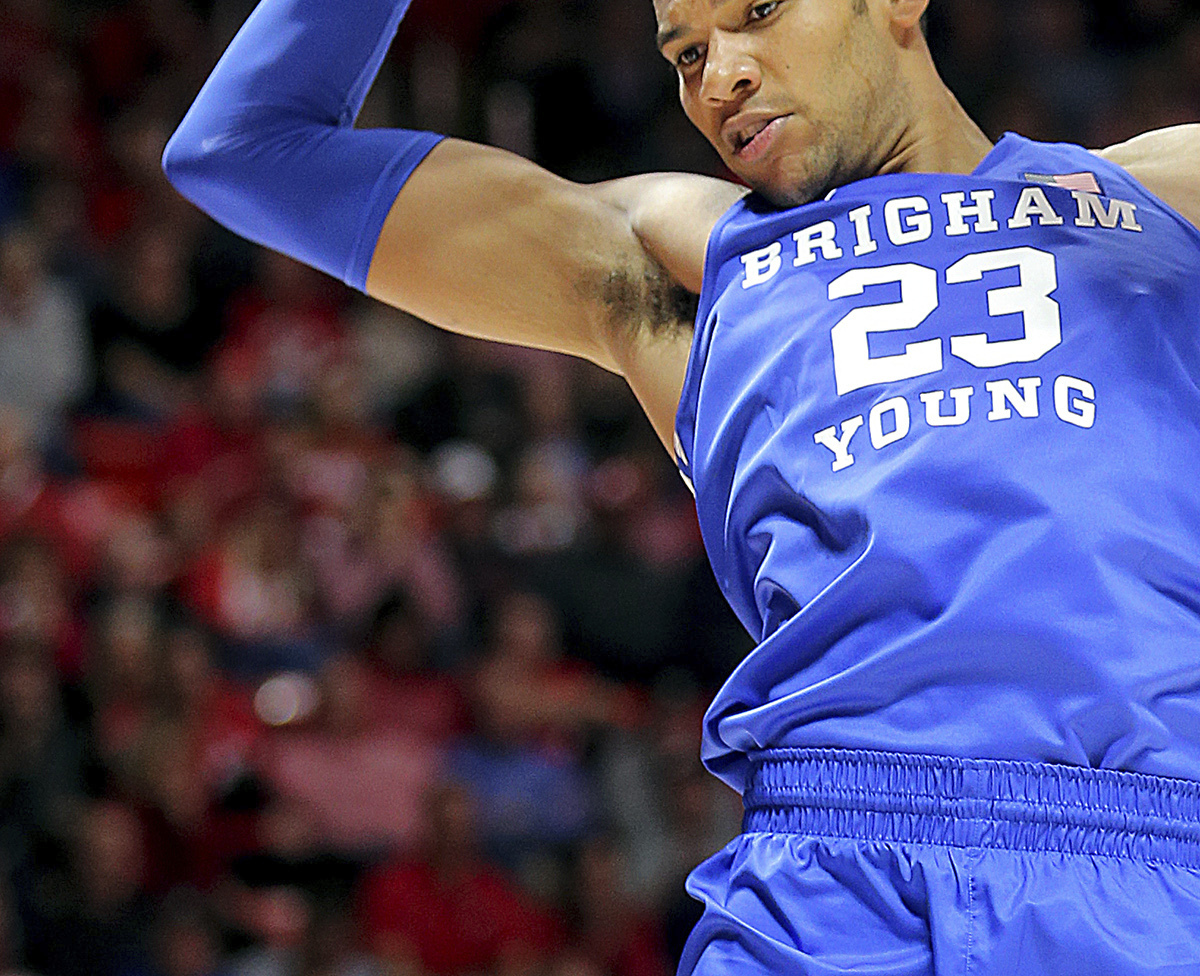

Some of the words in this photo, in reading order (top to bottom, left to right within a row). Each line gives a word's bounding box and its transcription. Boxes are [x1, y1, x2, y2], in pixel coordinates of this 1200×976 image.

[741, 188, 1142, 289] BRIGHAM
[827, 246, 1062, 396] 23
[814, 375, 1096, 472] YOUNG
